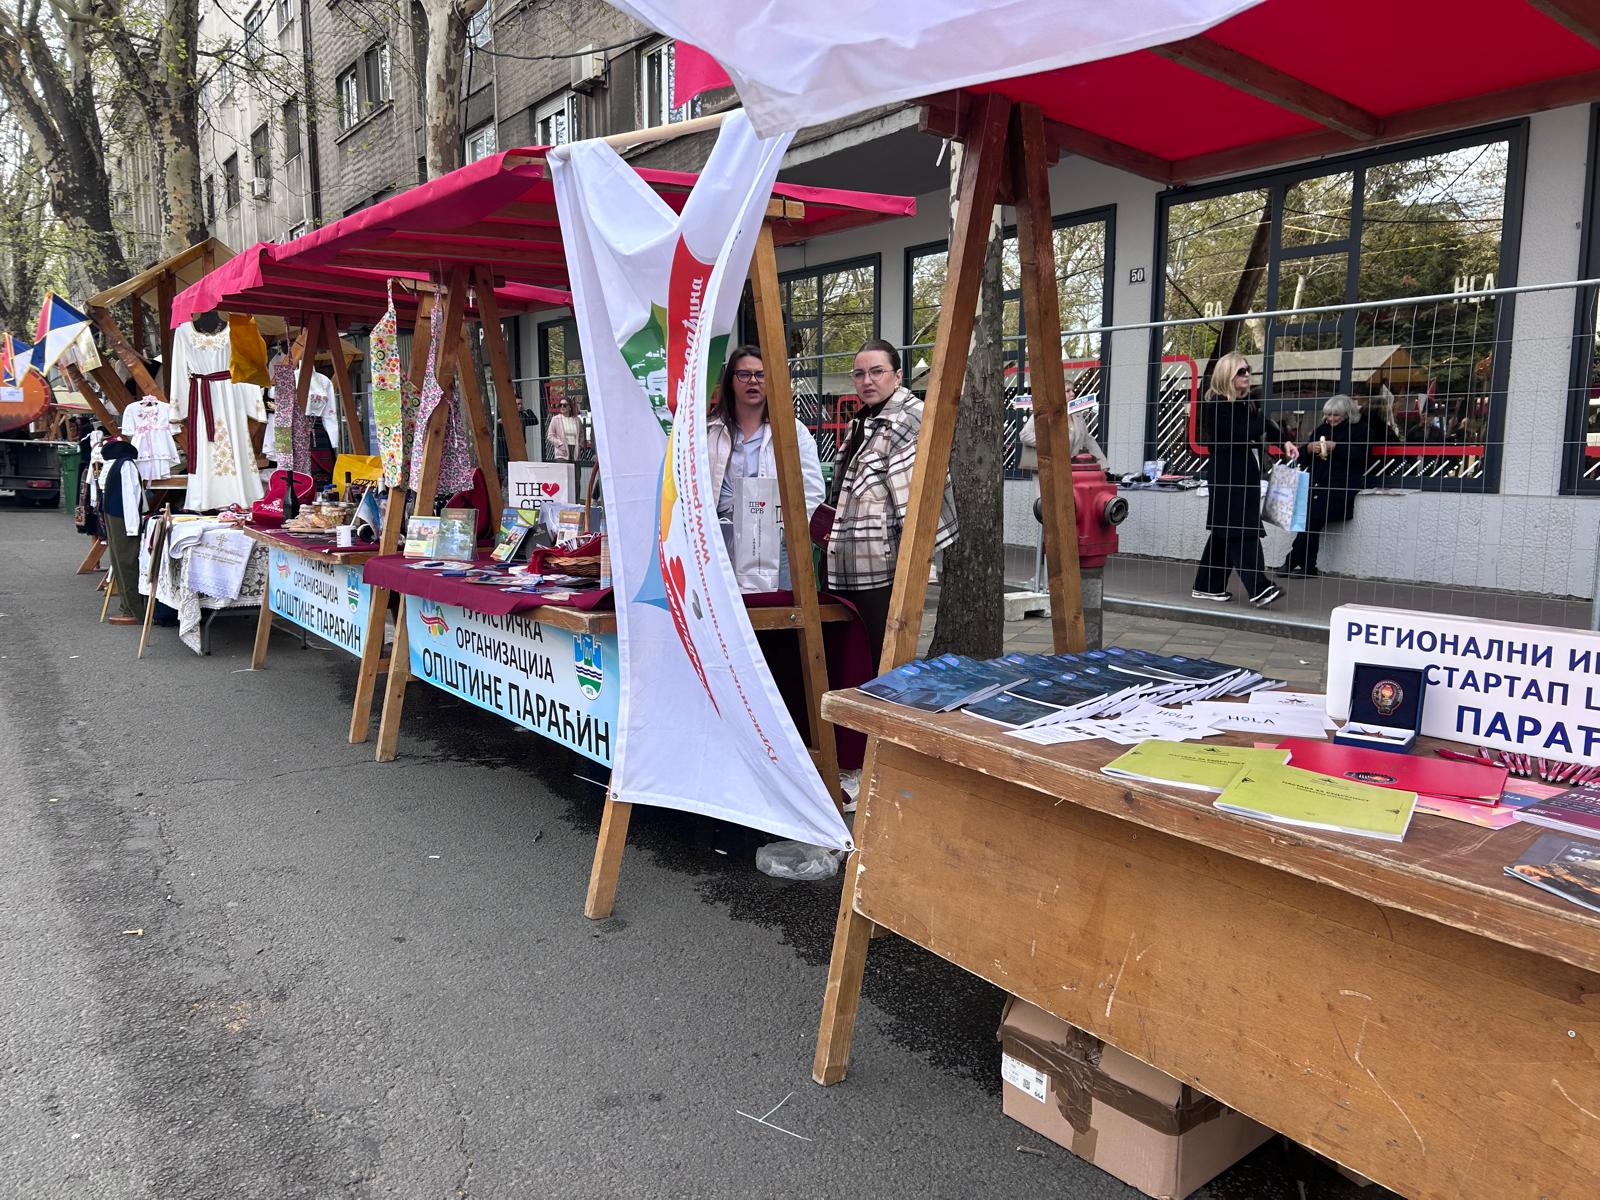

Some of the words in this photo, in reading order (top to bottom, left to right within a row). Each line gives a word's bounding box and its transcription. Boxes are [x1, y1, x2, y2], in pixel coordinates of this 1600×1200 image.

[1131, 269, 1144, 282] 50
[515, 482, 543, 497] ПН
[520, 498, 554, 510] СР
[293, 570, 339, 605] ОРГАНИЗАЦИЈА
[275, 588, 315, 628] ОПШТИНЕ
[317, 607, 361, 652] ПАРАЋИН
[455, 626, 555, 684] ОРГАНИЗАЦИЈА
[1347, 621, 1553, 668] РЕГИОНАЛНИ
[422, 647, 503, 710] ОПШТИНЕ
[508, 682, 610, 761] ПАРАЋИН
[1424, 664, 1569, 706] СТАРТАП
